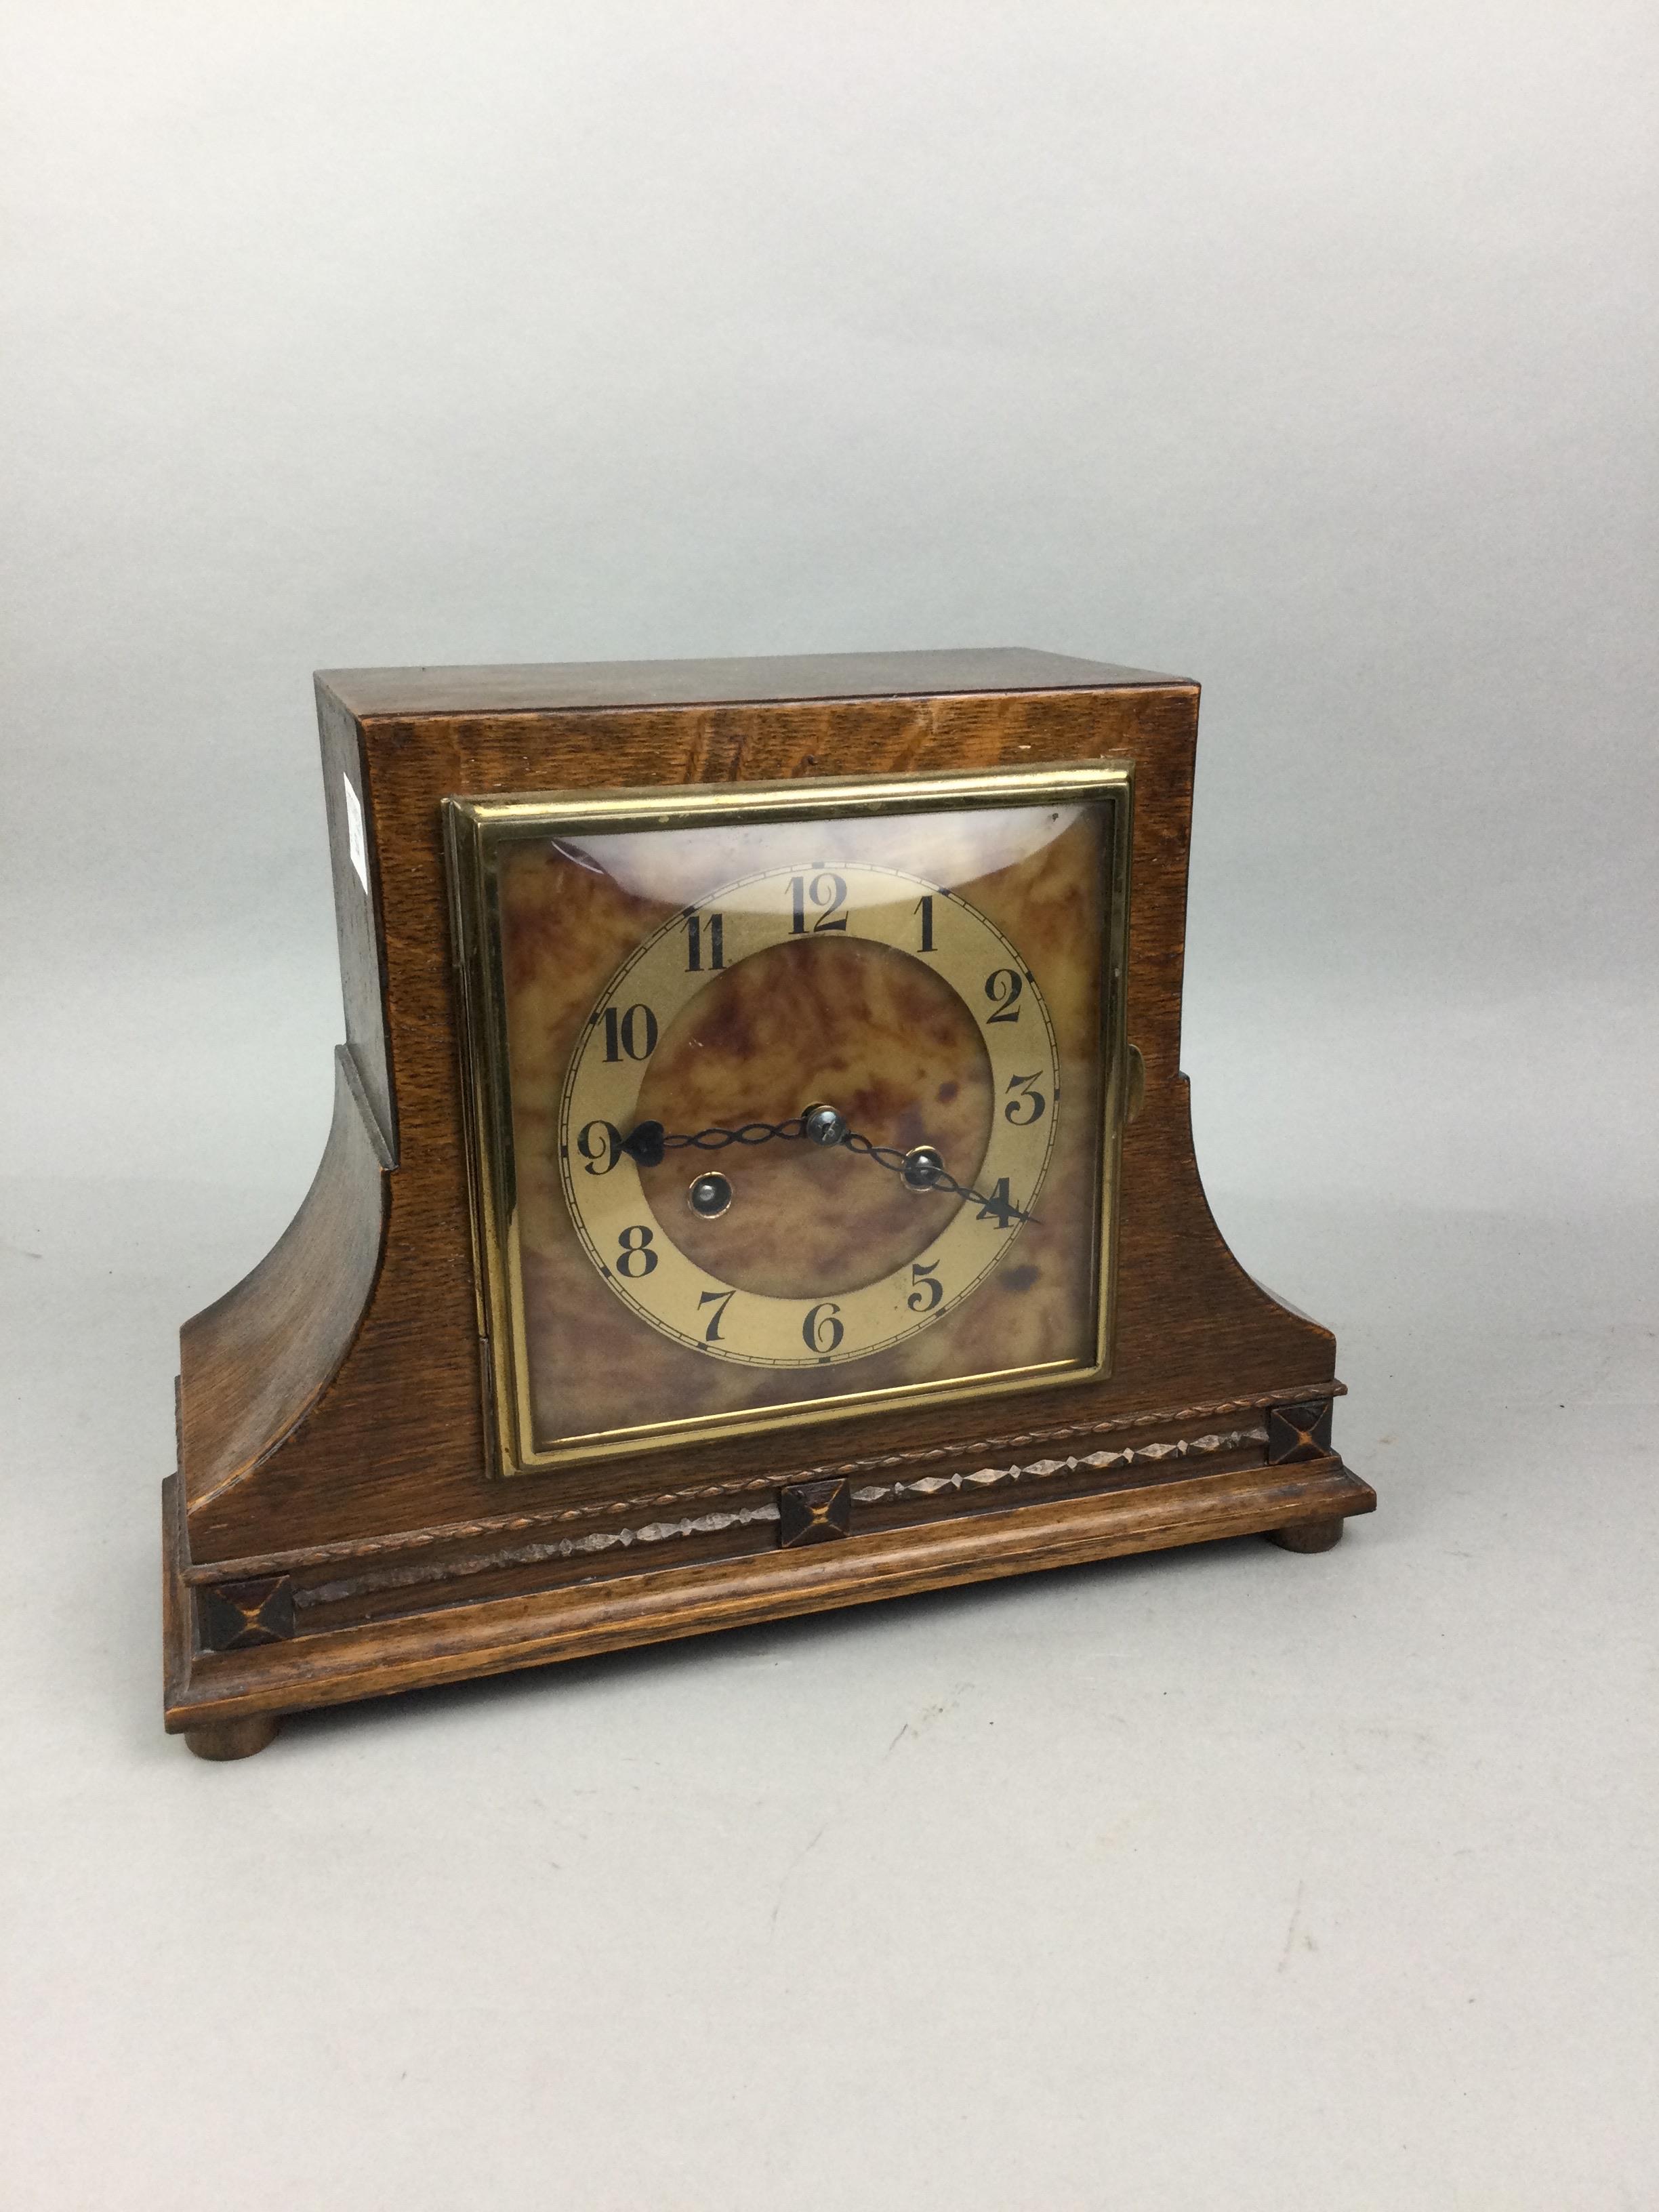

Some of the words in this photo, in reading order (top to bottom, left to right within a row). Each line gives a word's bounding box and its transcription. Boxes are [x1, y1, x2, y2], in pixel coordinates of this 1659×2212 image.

[784, 872, 848, 935] 12
[913, 895, 938, 953] 1
[680, 913, 727, 972] 11
[984, 968, 1021, 1024] 2
[598, 1004, 657, 1063] 10
[1004, 1071, 1045, 1125] 3
[577, 1120, 621, 1176] 9
[976, 1178, 1021, 1229] 4
[616, 1225, 657, 1278] 8
[908, 1259, 943, 1312] 5
[697, 1290, 736, 1342] 7
[802, 1303, 844, 1353] 6
